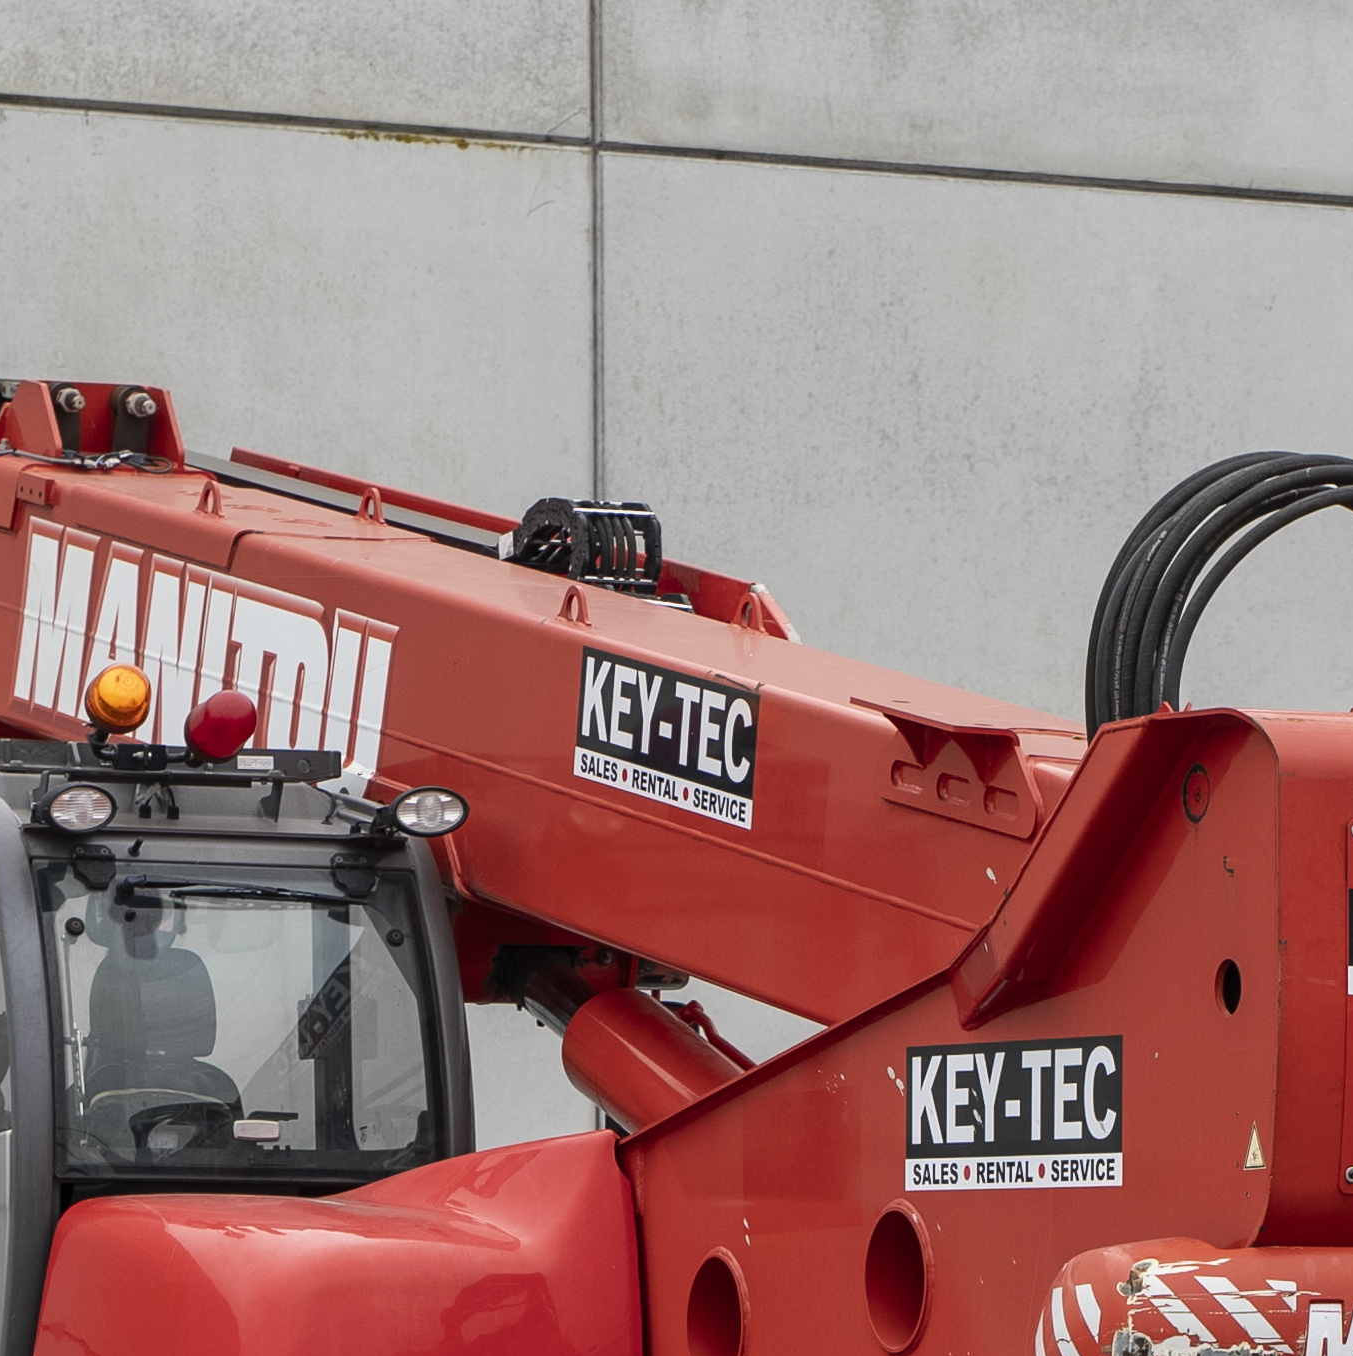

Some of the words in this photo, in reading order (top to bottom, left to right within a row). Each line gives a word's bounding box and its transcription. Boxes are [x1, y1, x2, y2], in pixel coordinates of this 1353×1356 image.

[13, 528, 396, 800] MANITOU
[581, 656, 753, 783] KEY-TEC
[580, 753, 618, 782] SALES
[631, 768, 679, 802] RENTAL
[692, 787, 746, 823] SERVICE
[911, 1045, 1117, 1145] KEY-TEC
[912, 1162, 959, 1186] SALES
[976, 1160, 1034, 1184] RENTAL
[1050, 1158, 1116, 1182] SERVICE
